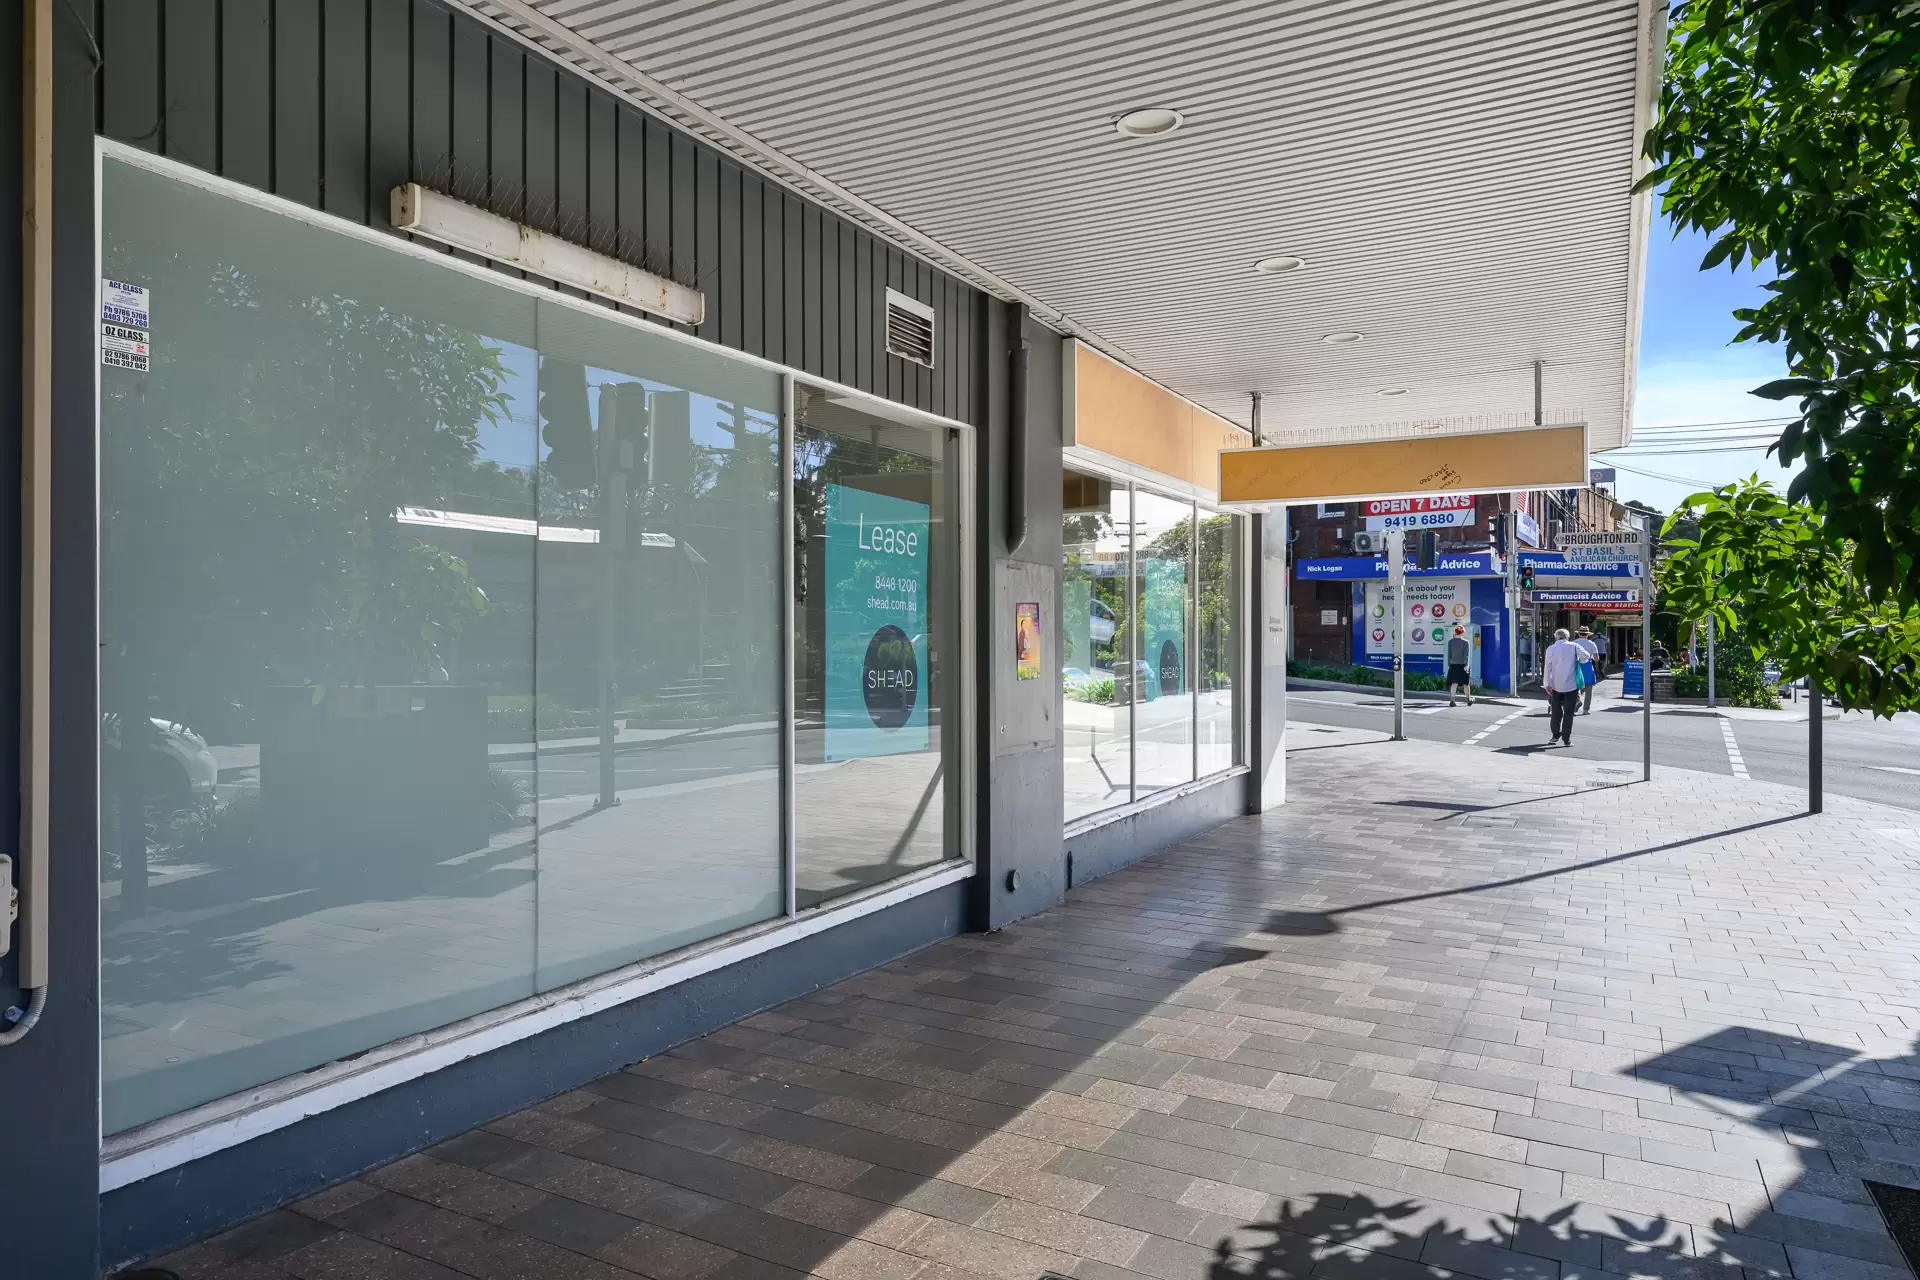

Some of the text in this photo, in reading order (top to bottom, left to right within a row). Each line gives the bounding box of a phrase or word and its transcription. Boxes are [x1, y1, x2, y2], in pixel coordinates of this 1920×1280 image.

[109, 281, 121, 290] ACE
[122, 283, 143, 294] GLASS
[104, 305, 113, 313] Ph
[106, 326, 116, 336] OZ
[118, 328, 143, 341] GLASS
[1370, 496, 1472, 514] OPEN 7 DAYS
[1384, 514, 1455, 527] 9419 6880
[858, 512, 918, 556] Lease
[1565, 534, 1622, 544] BROUGHTON
[1624, 534, 1638, 543] RD
[1323, 565, 1342, 573] Logan
[1441, 559, 1480, 570] Advice
[1524, 558, 1584, 570] Pharmacist
[1585, 563, 1618, 571] Advice
[875, 576, 917, 593] 8448 1200
[1157, 575, 1180, 596] Lease
[1439, 585, 1456, 593] your
[1430, 593, 1455, 601] today!
[867, 597, 917, 612] shead.com.au
[868, 670, 914, 690] SHEAD
